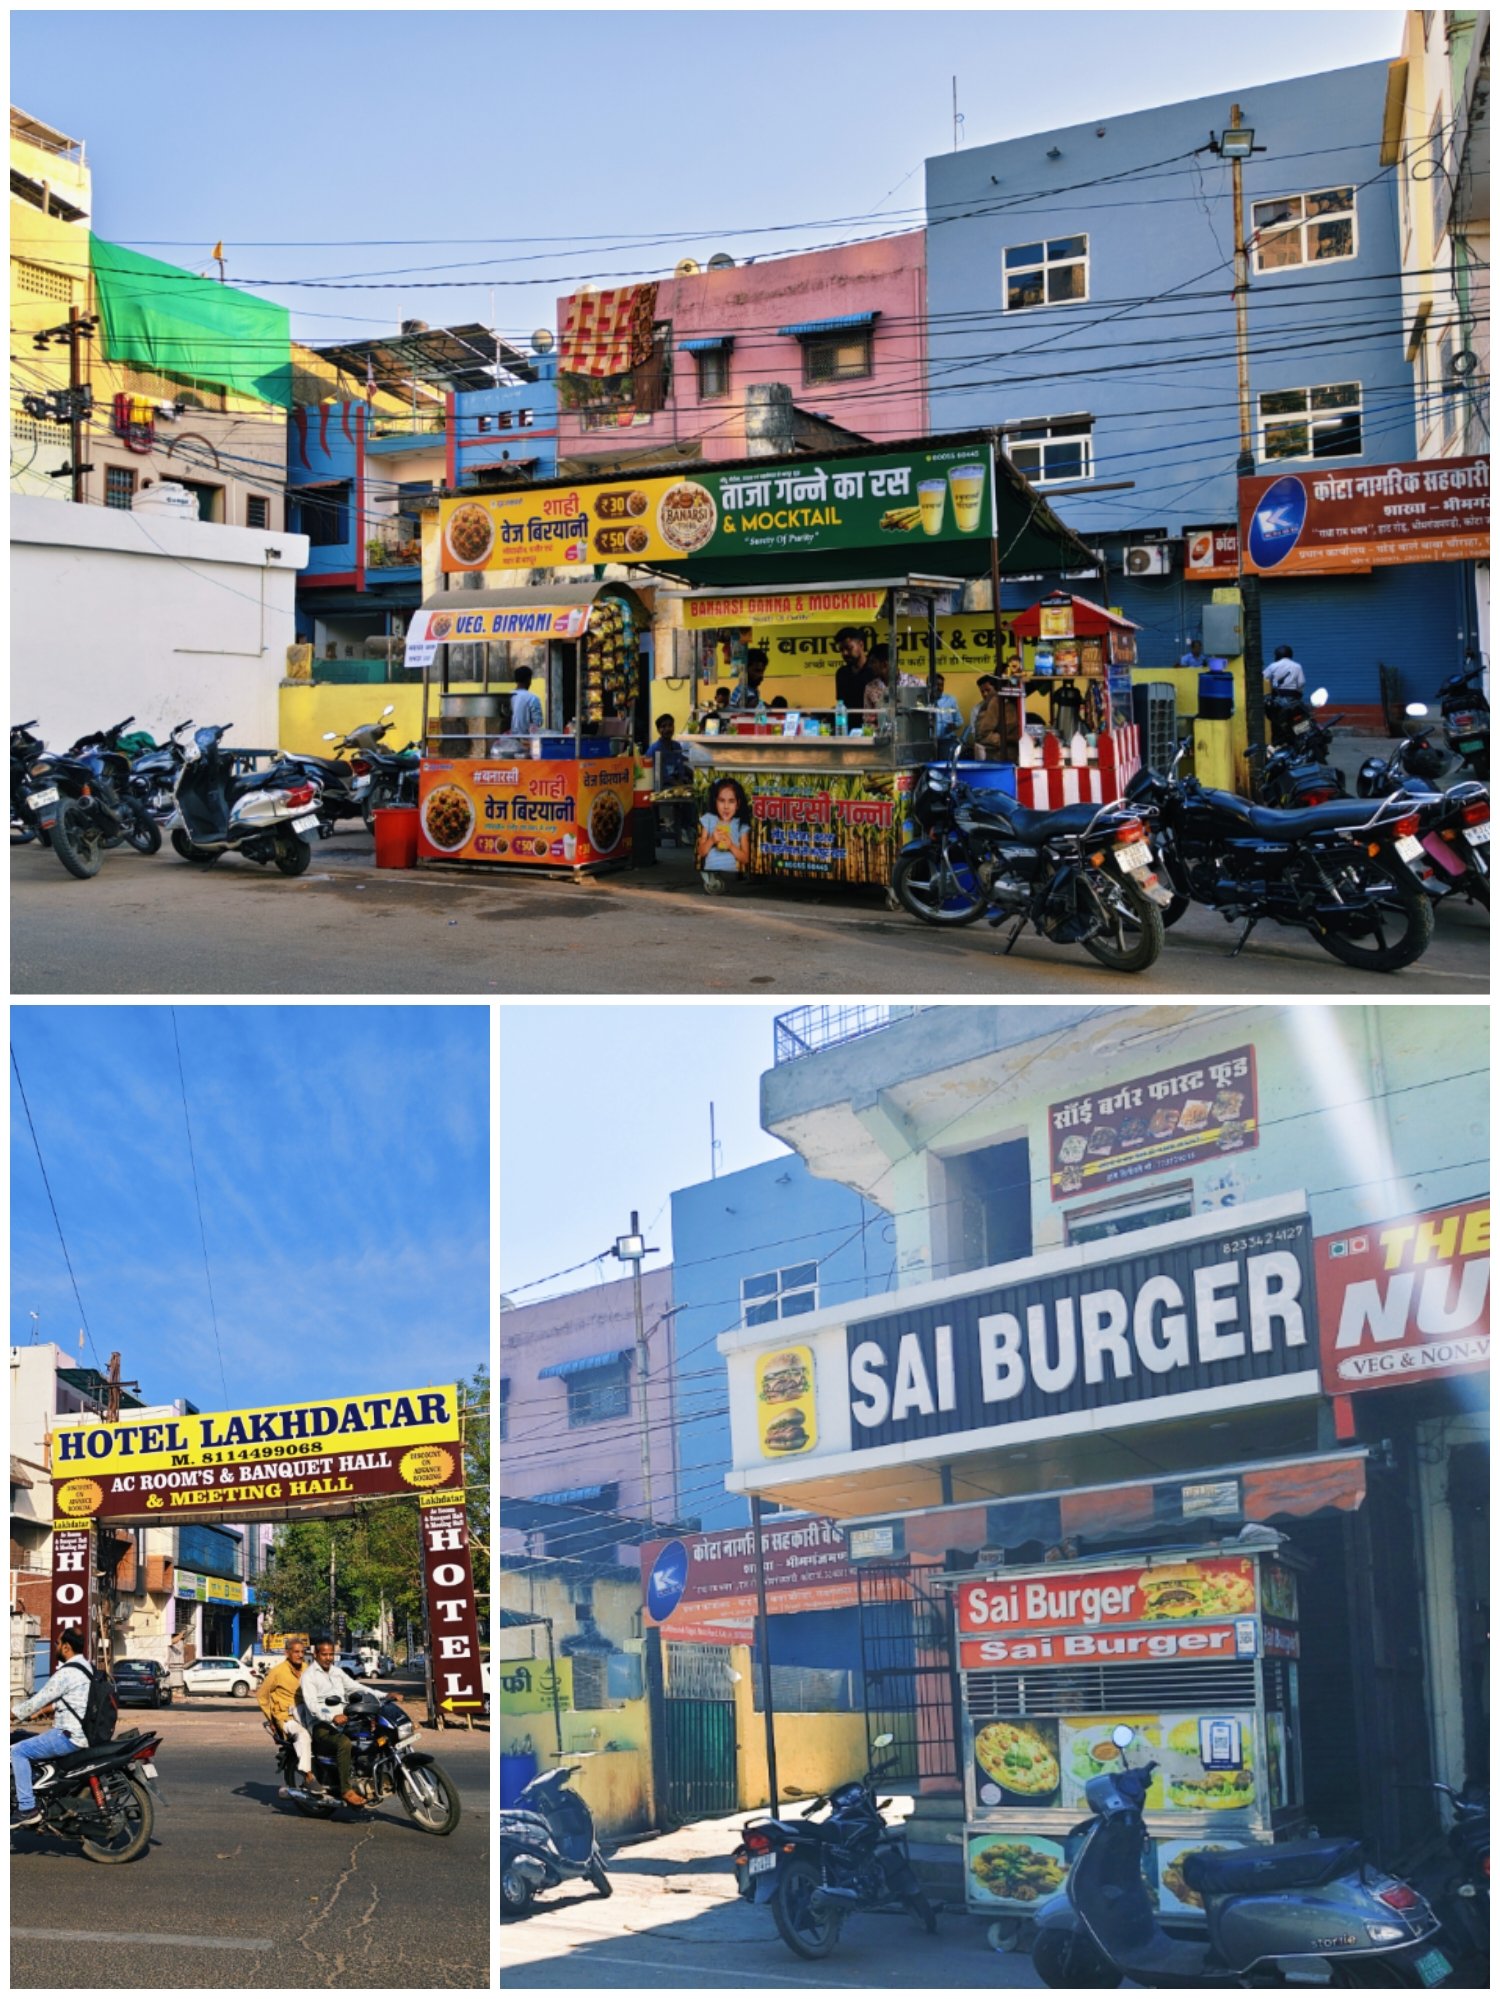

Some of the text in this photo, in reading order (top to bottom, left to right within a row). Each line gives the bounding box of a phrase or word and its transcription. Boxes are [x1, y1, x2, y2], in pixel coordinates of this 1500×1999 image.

[719, 479, 773, 510] ताजा
[774, 466, 829, 506] गन्ने
[832, 471, 869, 500] का
[871, 467, 912, 497] रस
[1313, 459, 1490, 501] कोटा नागरिक सहकारी
[543, 491, 580, 517] शाही
[665, 507, 708, 525] BANARSI
[722, 506, 842, 534] & MOCKTAIL
[1384, 503, 1427, 517] शाखा
[500, 512, 590, 544] वेज बिरयानी
[690, 591, 879, 618] BANARSI GANNA & MOCKTAIL
[455, 615, 487, 634] VEG.
[492, 613, 553, 634] BIRYANI
[757, 636, 770, 654] #
[951, 628, 968, 649] &
[529, 774, 565, 799] शाही
[484, 793, 575, 822] वेज बिरयानी
[751, 790, 895, 829] बनारसी गन्ना
[1097, 1084, 1144, 1116] बर्गर
[1147, 1070, 1205, 1100] फास्ट
[1209, 1056, 1248, 1088] फूड
[1379, 1207, 1490, 1271] THE
[850, 1250, 1309, 1429] SAI BURGER
[1352, 1354, 1395, 1375] VEG
[1400, 1352, 1416, 1369] &
[58, 1393, 450, 1461] HOTEL LAKHDATAR
[171, 1441, 323, 1467] M. 8114499068
[111, 1452, 392, 1493] AC ROOM'S & BANQUET HALL
[146, 1477, 354, 1509] & MEETING HALL
[420, 1495, 464, 1506] Lakhdatar
[54, 1520, 89, 1529] Lakhdatar
[692, 1536, 722, 1562] कोटा
[771, 1523, 821, 1552] सहकारी
[428, 1527, 474, 1697] HOTEL
[968, 1580, 1137, 1627] Sai Burger
[979, 1629, 1234, 1662] Sai Burger
